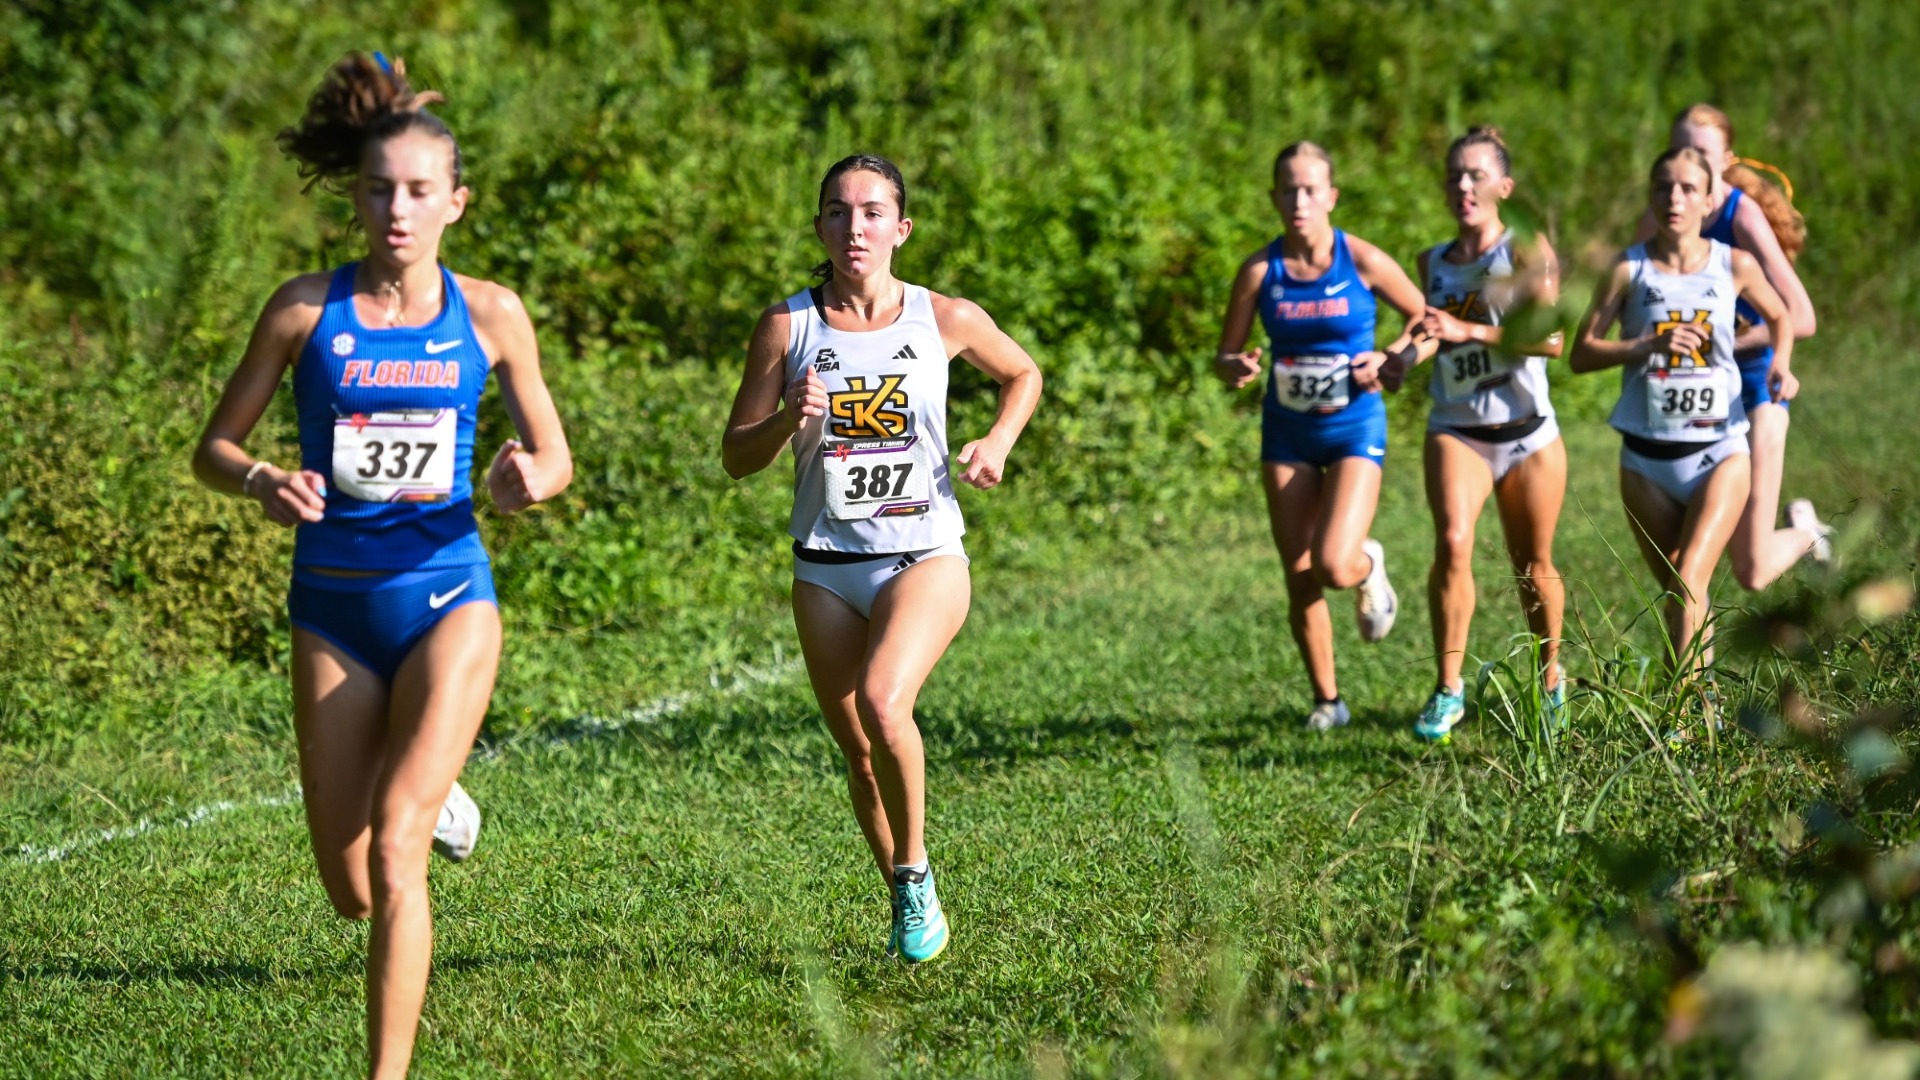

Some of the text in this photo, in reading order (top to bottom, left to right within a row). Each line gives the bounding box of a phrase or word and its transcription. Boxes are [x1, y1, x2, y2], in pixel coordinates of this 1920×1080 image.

[1276, 297, 1349, 320] FLORIDA
[340, 359, 460, 389] FLORIDA
[813, 361, 840, 373] USA
[1453, 348, 1492, 384] 381
[1288, 375, 1335, 399] 332
[1661, 387, 1715, 413] 389
[356, 440, 438, 479] 337
[844, 463, 914, 500] 387
